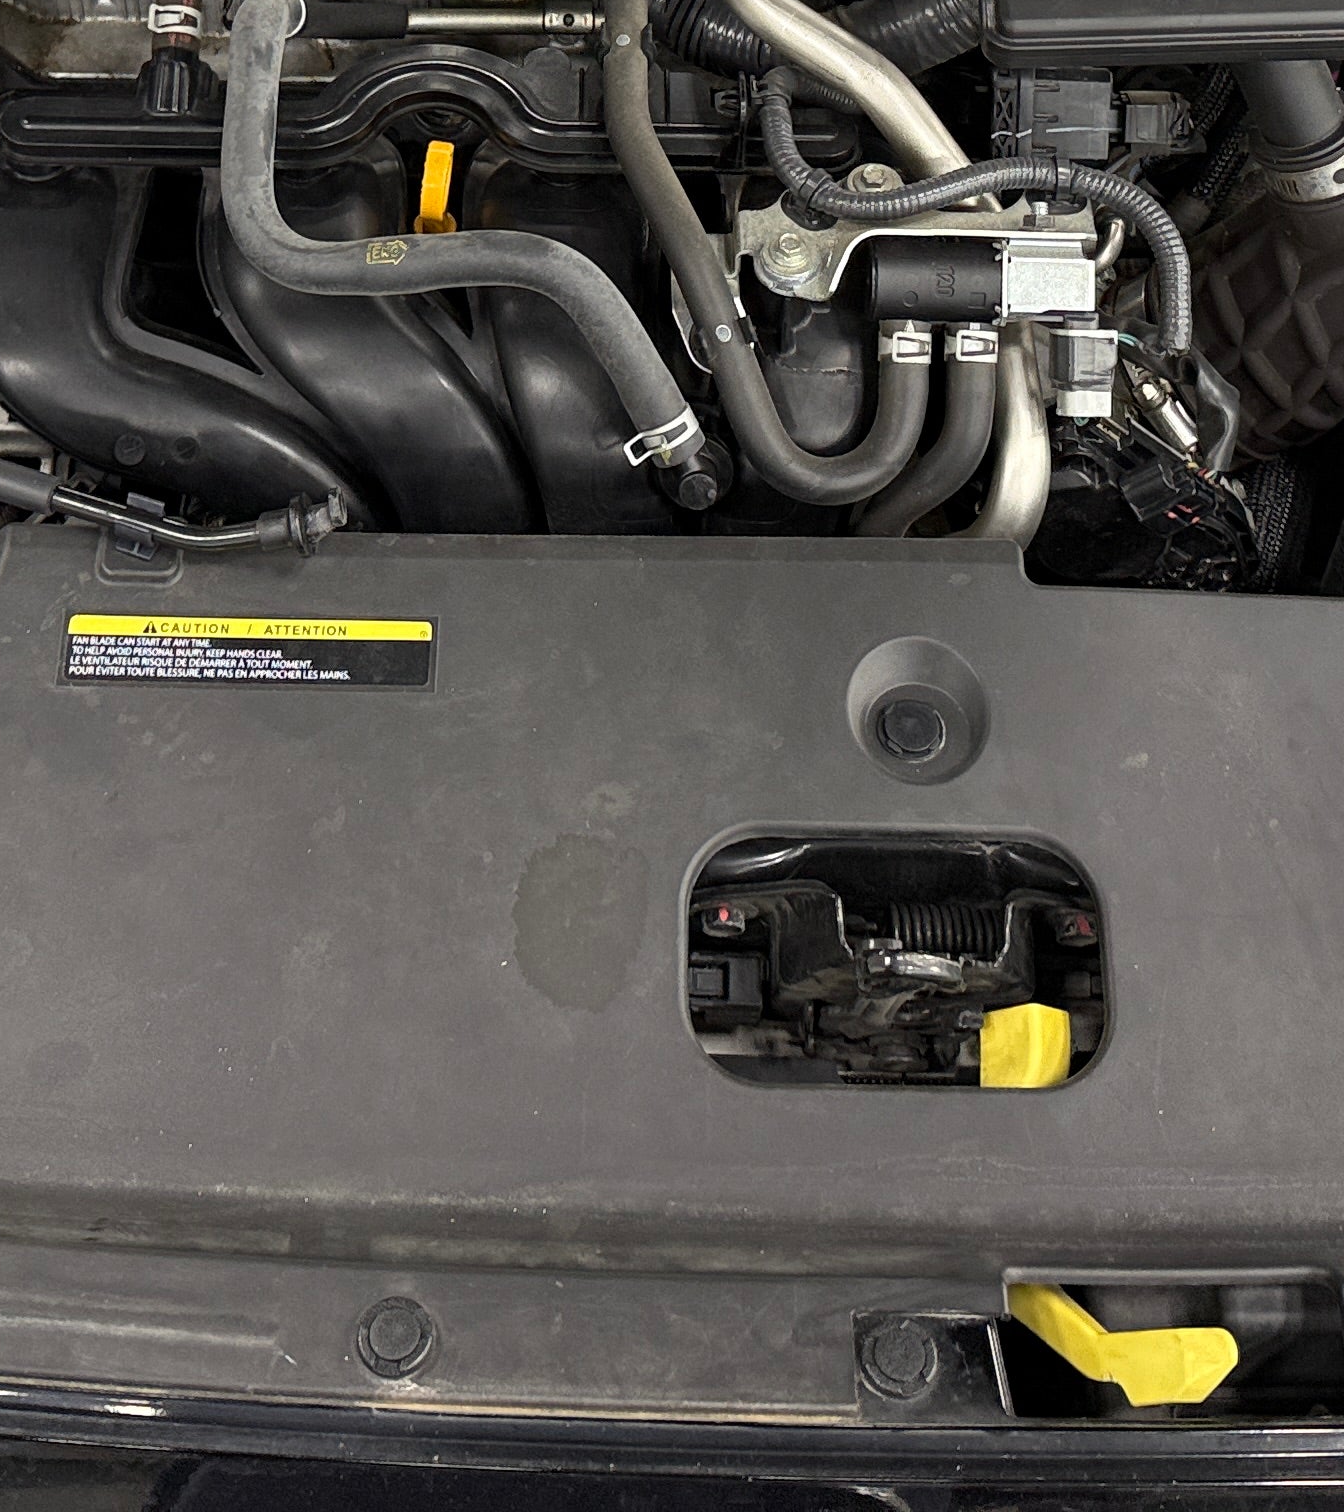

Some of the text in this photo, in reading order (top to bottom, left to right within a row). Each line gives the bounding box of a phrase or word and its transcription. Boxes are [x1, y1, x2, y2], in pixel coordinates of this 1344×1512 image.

[161, 622, 229, 634] CAUTION
[263, 624, 347, 636] ATTENTION
[72, 637, 89, 645] FAN
[90, 637, 116, 645] BLADE
[117, 637, 135, 646] CAN
[136, 638, 160, 646] START
[161, 638, 172, 647] AT
[172, 639, 190, 647] ANY
[72, 646, 84, 655] TO
[84, 646, 106, 656] HELP
[106, 647, 132, 656] AVOID
[132, 647, 174, 657] PERSONAL
[205, 649, 225, 658] KEEP
[226, 649, 255, 659] HANDS
[70, 655, 80, 665] LE
[81, 656, 139, 666] VENTILATEUR
[141, 657, 173, 668] RISQUE
[175, 658, 187, 667] DE
[188, 657, 236, 668] DÉMARRER
[246, 659, 270, 669] TOUT
[270, 660, 314, 670] MOMENT.
[68, 665, 94, 675] POUR
[95, 664, 125, 676] ÉVITER
[126, 667, 155, 676] TOUTE
[156, 668, 202, 679] BLESSURE,
[203, 668, 216, 678] NE
[216, 669, 233, 678] PAS
[235, 669, 248, 678] EN
[248, 670, 302, 680] APPROCHER
[302, 670, 319, 680] LES
